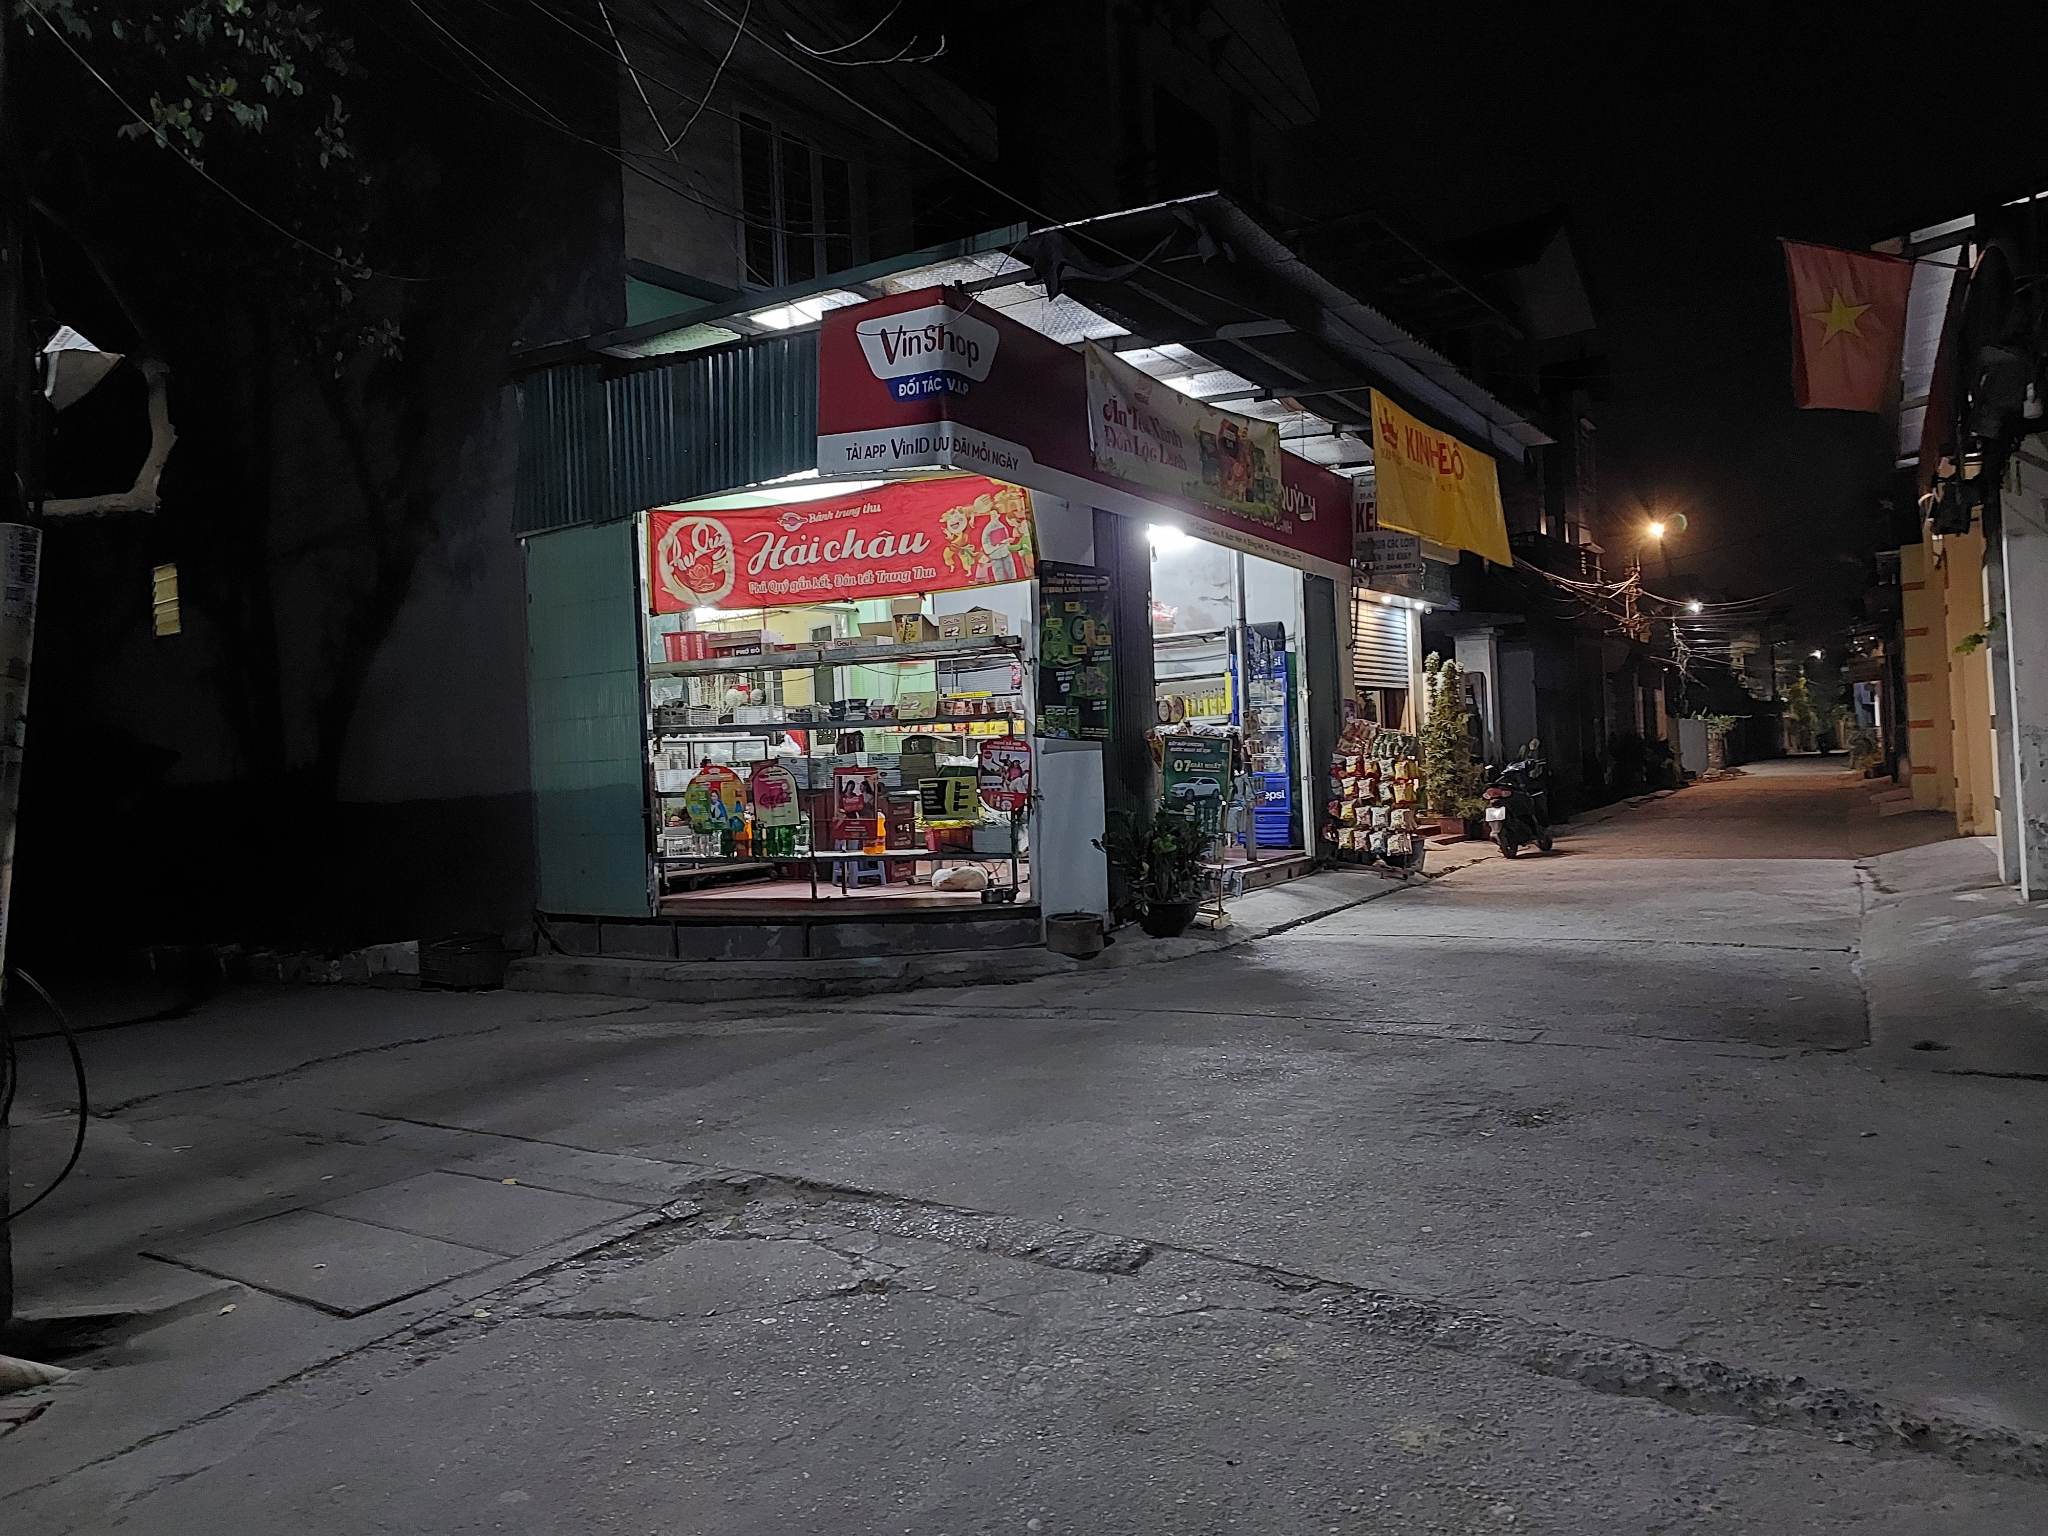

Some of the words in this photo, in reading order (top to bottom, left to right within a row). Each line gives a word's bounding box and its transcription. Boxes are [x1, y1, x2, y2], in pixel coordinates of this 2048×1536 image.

[880, 323, 980, 368] VinShop
[898, 377, 920, 397] ĐỐI
[922, 375, 942, 394] TÁC
[846, 441, 862, 461] TẢI
[864, 445, 887, 460] APP
[890, 435, 930, 460] VinID
[992, 451, 1019, 472] NGÀY
[808, 510, 834, 524] Bánh
[834, 506, 861, 521] trung
[862, 502, 882, 515] thu
[767, 580, 790, 595] Quý
[876, 570, 911, 583] Trung
[912, 566, 936, 579] Thu
[1173, 759, 1191, 772] 07
[1264, 787, 1286, 801] epsi
